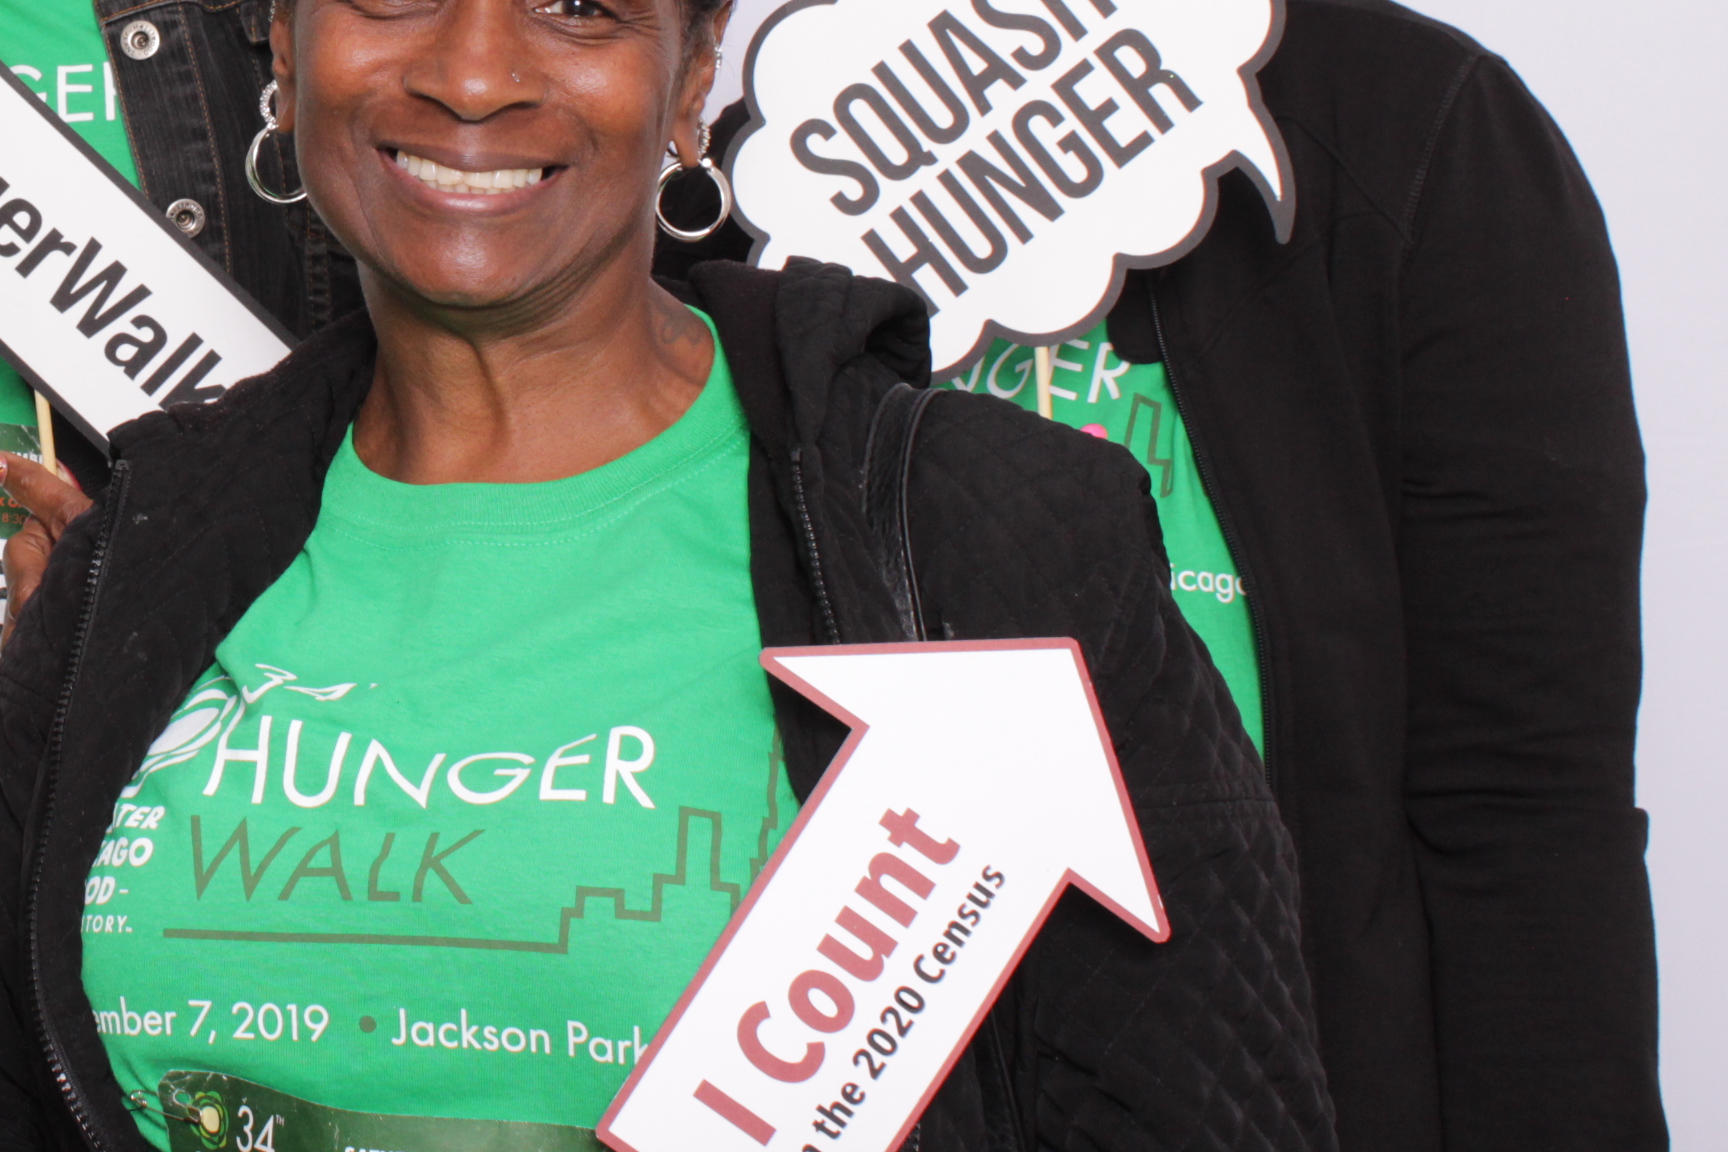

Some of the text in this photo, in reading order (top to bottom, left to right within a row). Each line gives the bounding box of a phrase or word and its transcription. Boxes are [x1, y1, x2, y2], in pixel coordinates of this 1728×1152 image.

[860, 28, 1204, 319] HUNGER
[202, 715, 656, 810] HUNGER
[190, 814, 485, 904] WALK
[188, 1000, 217, 1045] 7,
[232, 1001, 329, 1042] 2019
[391, 1008, 550, 1055] Jackson
[692, 807, 961, 1147] I Count
[812, 864, 1006, 1140] the 2020 Census
